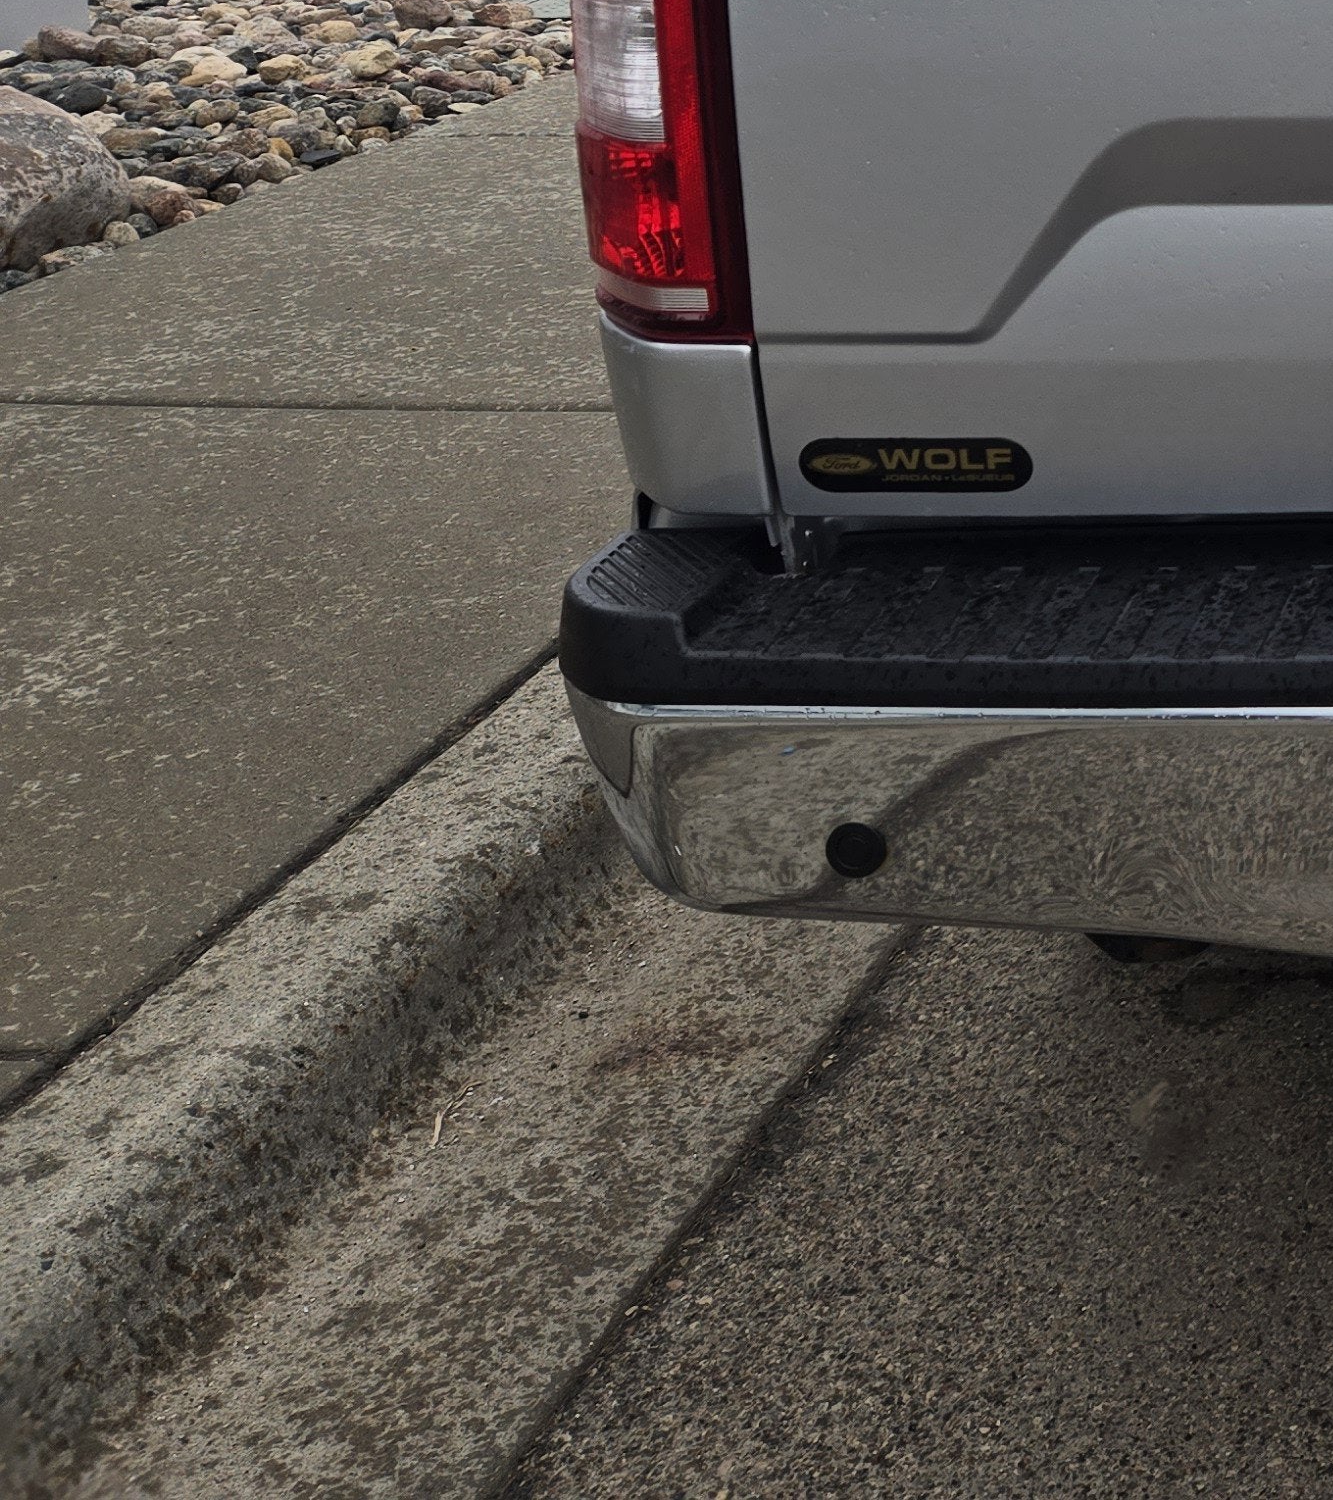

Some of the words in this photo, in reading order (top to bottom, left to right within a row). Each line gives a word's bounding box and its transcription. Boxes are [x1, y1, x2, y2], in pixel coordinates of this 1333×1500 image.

[822, 456, 861, 470] Ford
[878, 448, 1012, 470] WOLF
[881, 473, 942, 482] JORDAN
